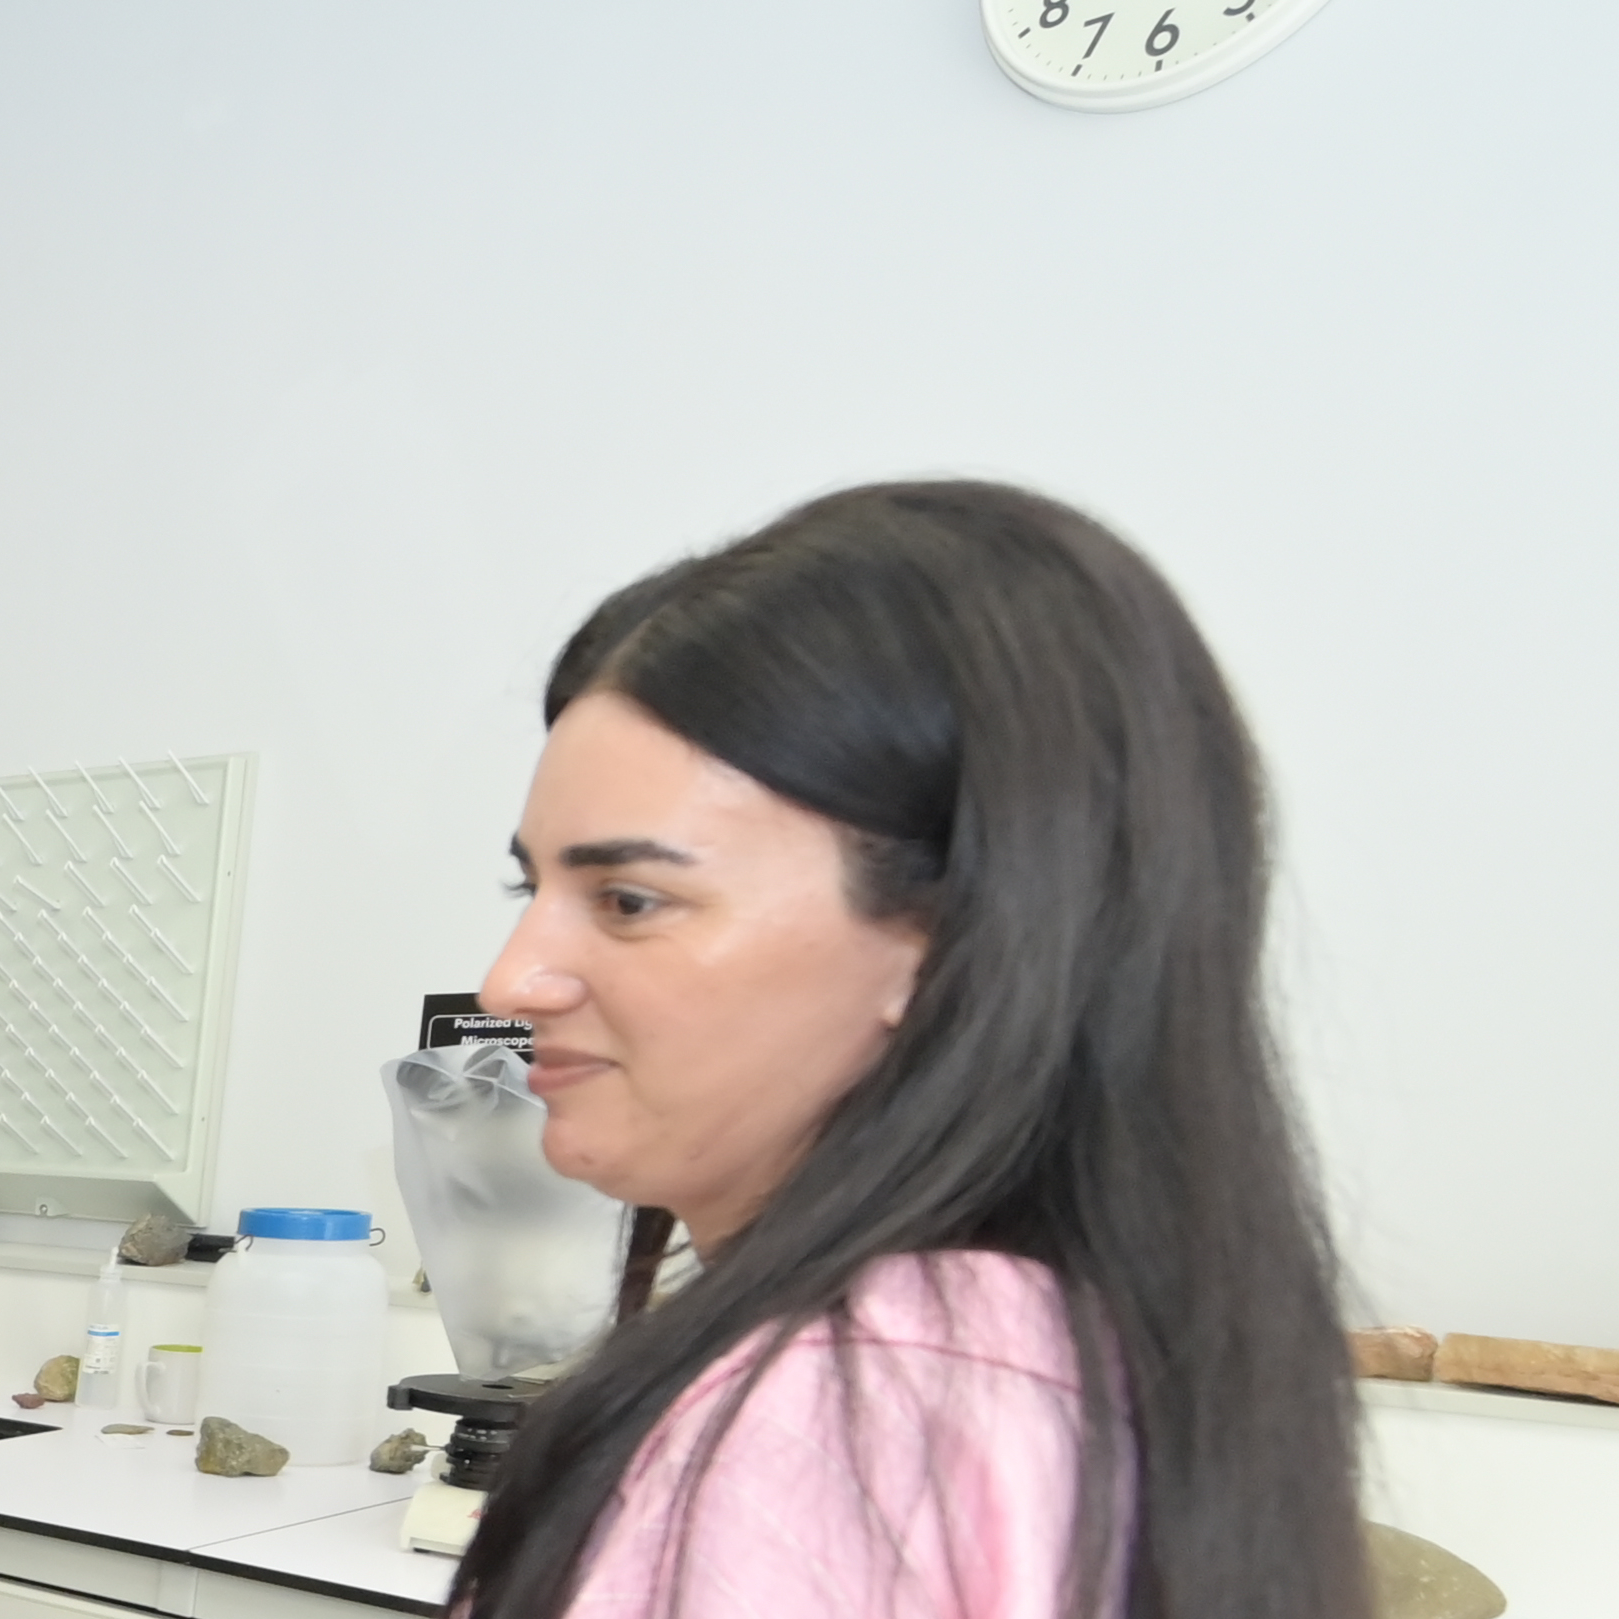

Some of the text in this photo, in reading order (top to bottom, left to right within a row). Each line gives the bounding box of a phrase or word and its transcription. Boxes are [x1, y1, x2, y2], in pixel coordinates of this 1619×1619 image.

[1081, 12, 1115, 60] 7
[1145, 7, 1180, 57] 6
[454, 1017, 534, 1031] Polarized Lig
